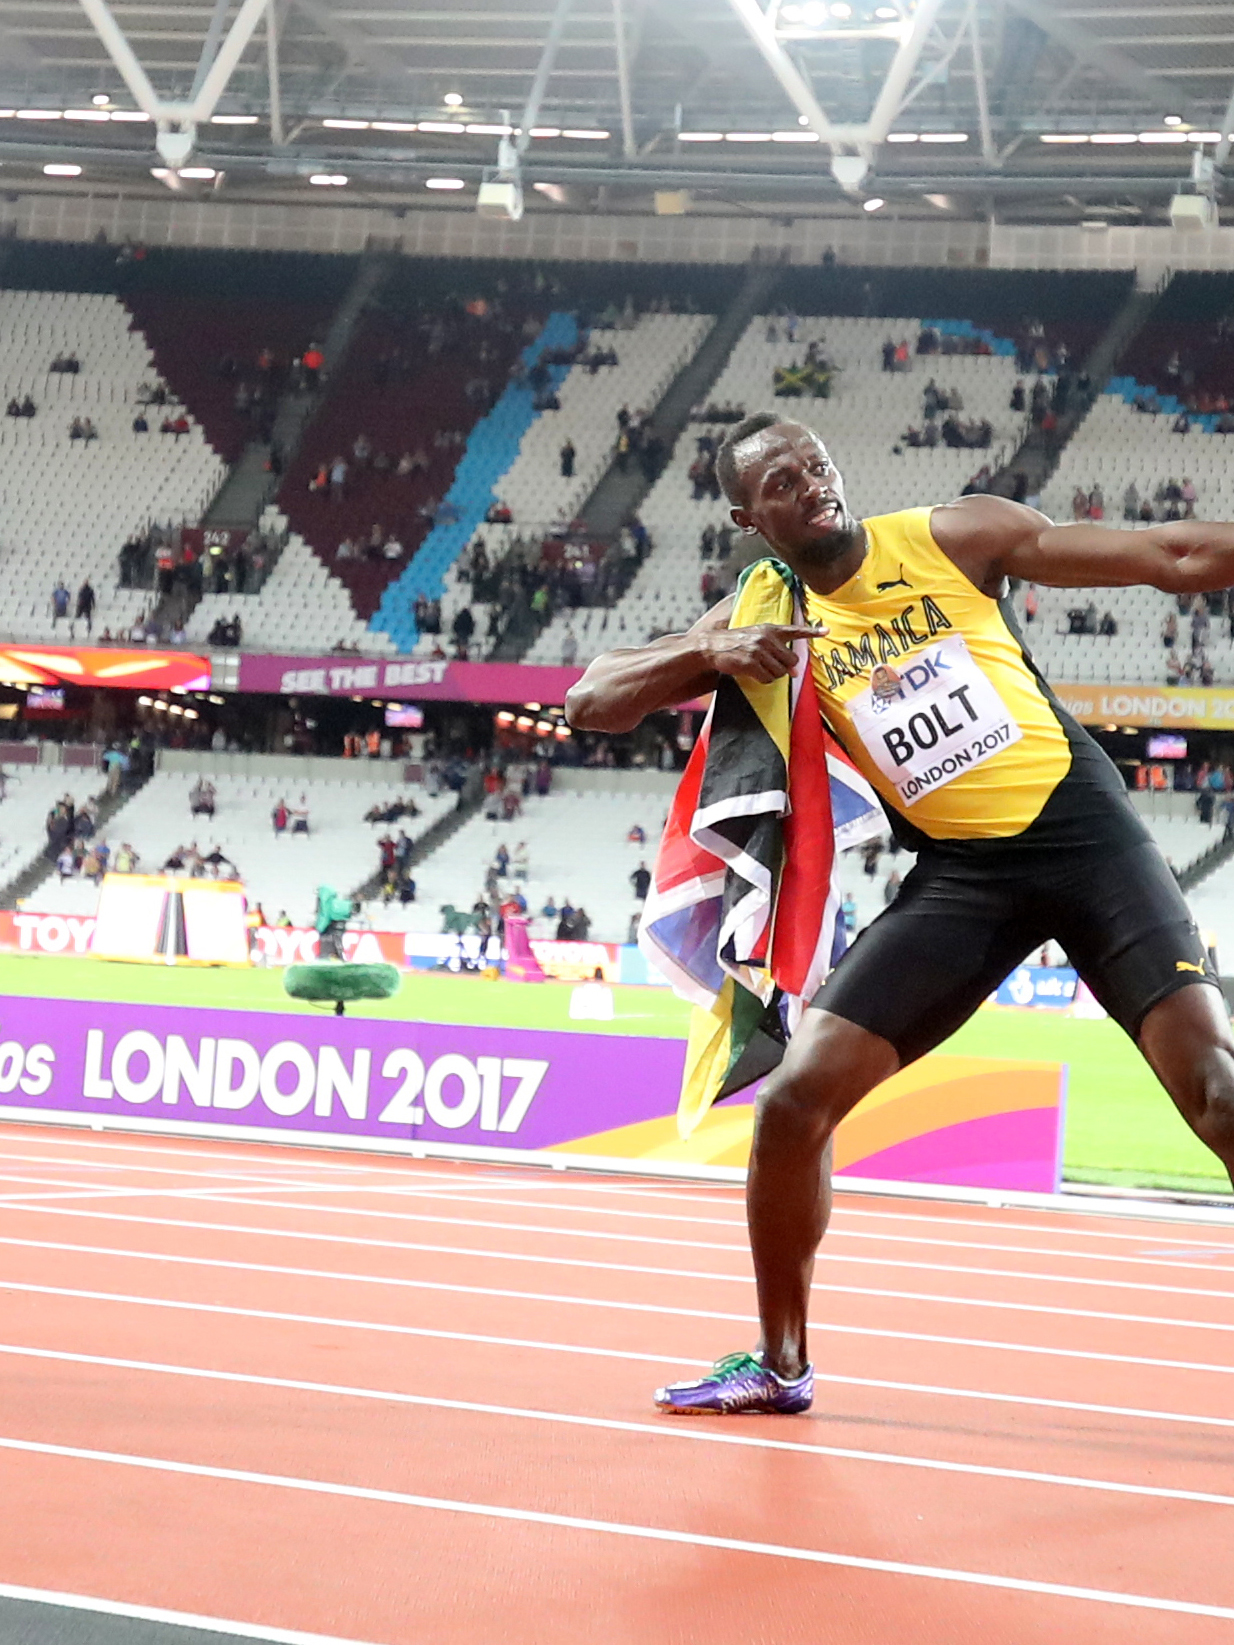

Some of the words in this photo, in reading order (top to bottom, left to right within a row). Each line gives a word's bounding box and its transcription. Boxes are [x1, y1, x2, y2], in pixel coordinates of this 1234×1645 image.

[328, 665, 379, 690] THE
[383, 660, 448, 687] BEST
[819, 594, 953, 691] JAMAICA
[882, 684, 979, 767] BOLT
[1101, 695, 1206, 719] LONDON
[900, 748, 973, 800] LONDON
[971, 724, 1012, 759] 2017
[13, 915, 96, 952] TOY
[82, 1028, 372, 1120] LONDON
[377, 1047, 550, 1133] 2017
